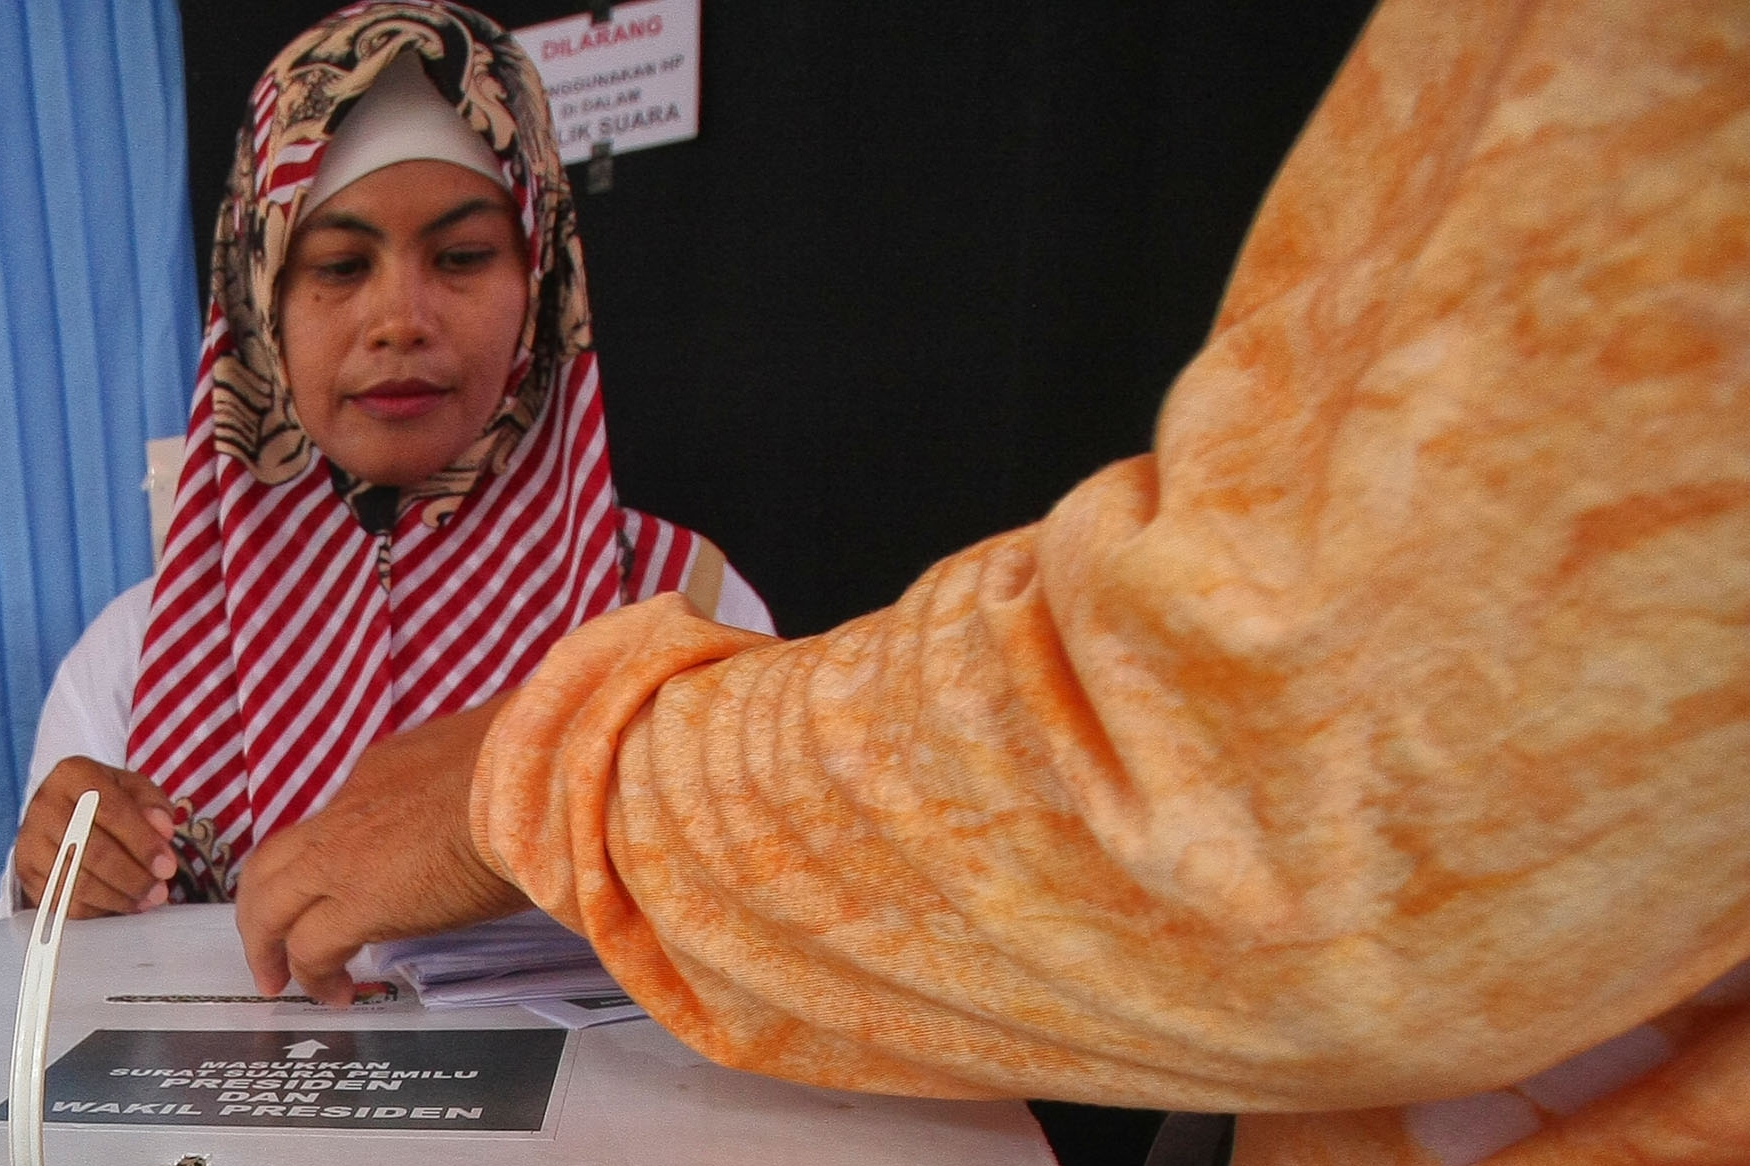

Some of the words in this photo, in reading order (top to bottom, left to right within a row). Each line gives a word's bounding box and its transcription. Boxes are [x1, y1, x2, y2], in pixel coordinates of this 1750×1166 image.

[599, 102, 681, 134] SUARA
[199, 1061, 390, 1071] MASUKKAN
[108, 1068, 212, 1078] SURAT
[223, 1069, 344, 1079] SUARA
[348, 1070, 479, 1080] PEMILU
[159, 1078, 403, 1092] PRESIDEN
[216, 1091, 320, 1104] DAN
[51, 1101, 203, 1116] WAKIL
[218, 1105, 484, 1120] PRESIDEN
